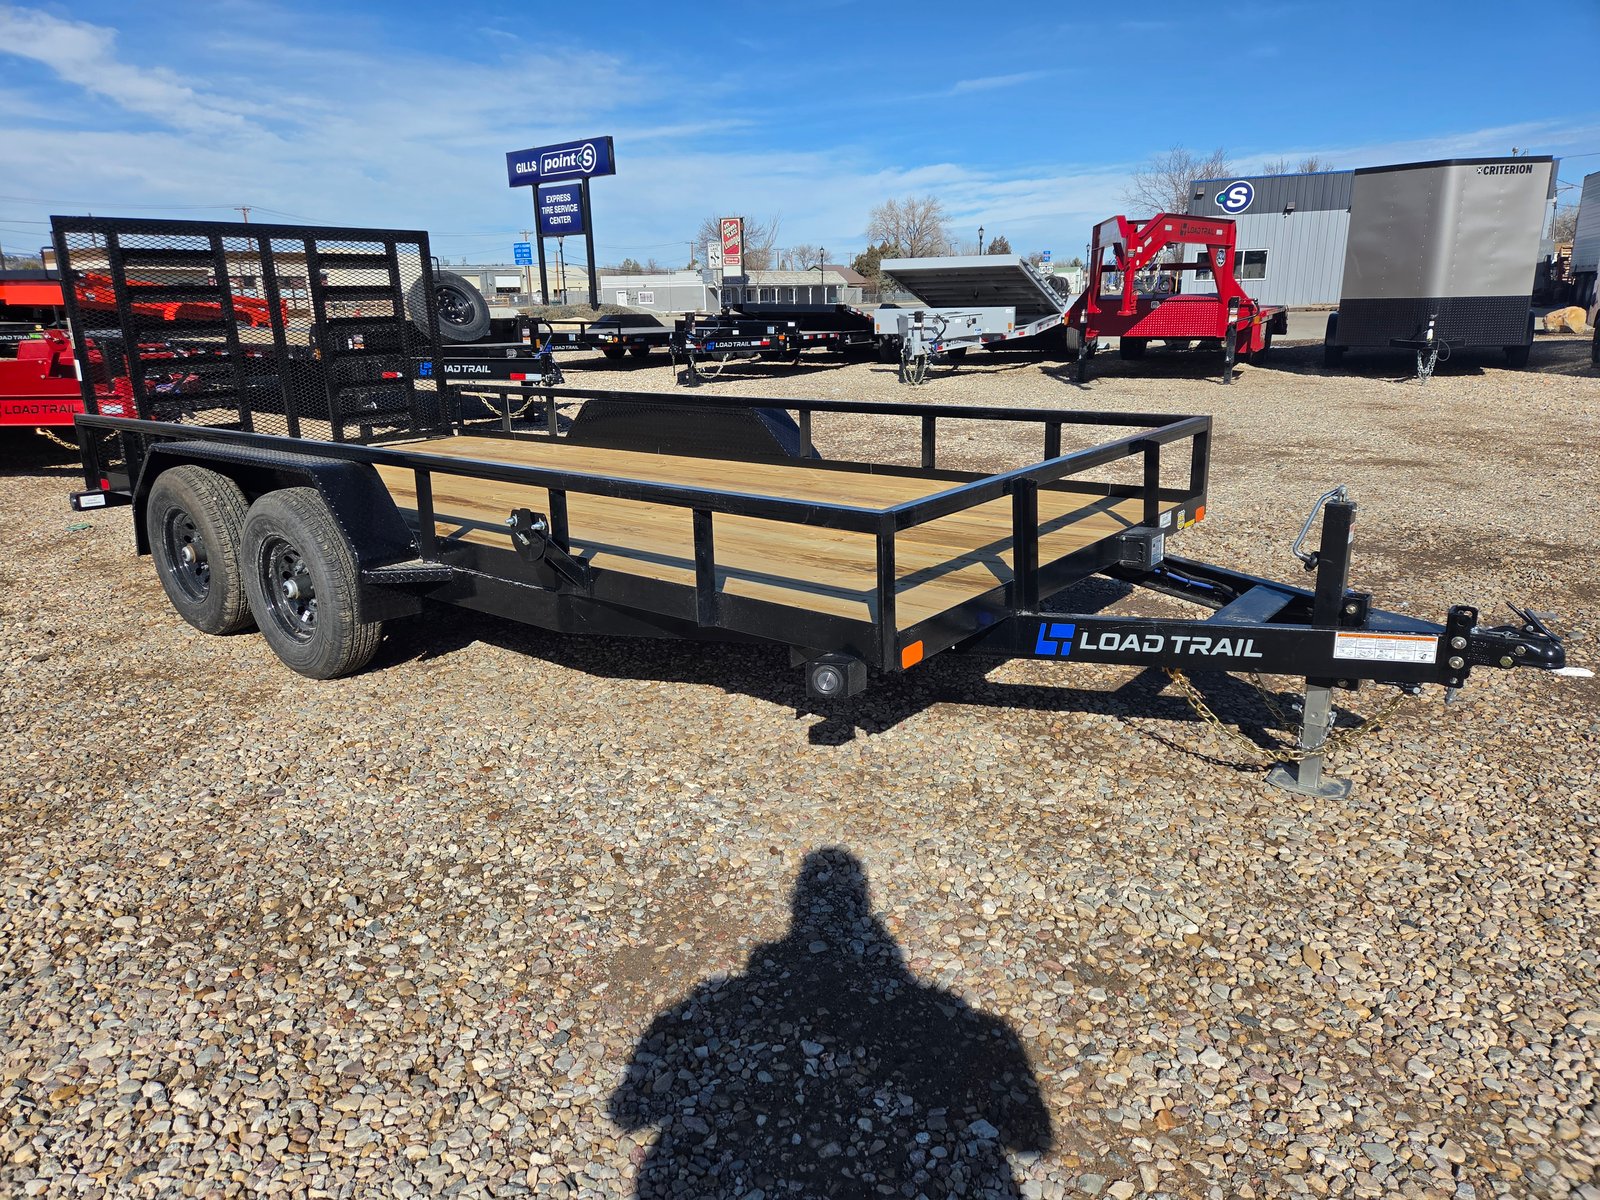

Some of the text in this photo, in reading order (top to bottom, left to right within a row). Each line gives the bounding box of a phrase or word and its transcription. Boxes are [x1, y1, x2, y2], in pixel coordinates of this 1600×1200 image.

[516, 149, 593, 173] GILLS point S
[1483, 164, 1533, 175] CRITERION
[546, 194, 571, 203] EXPRESS
[1226, 187, 1248, 207] S
[541, 203, 578, 214] TIRE SERVICE
[549, 215, 572, 225] CENTER
[462, 364, 492, 374] TRAIL
[5, 404, 79, 415] LOAD TRAIL
[1079, 632, 1263, 658] LOAD TRAIL
